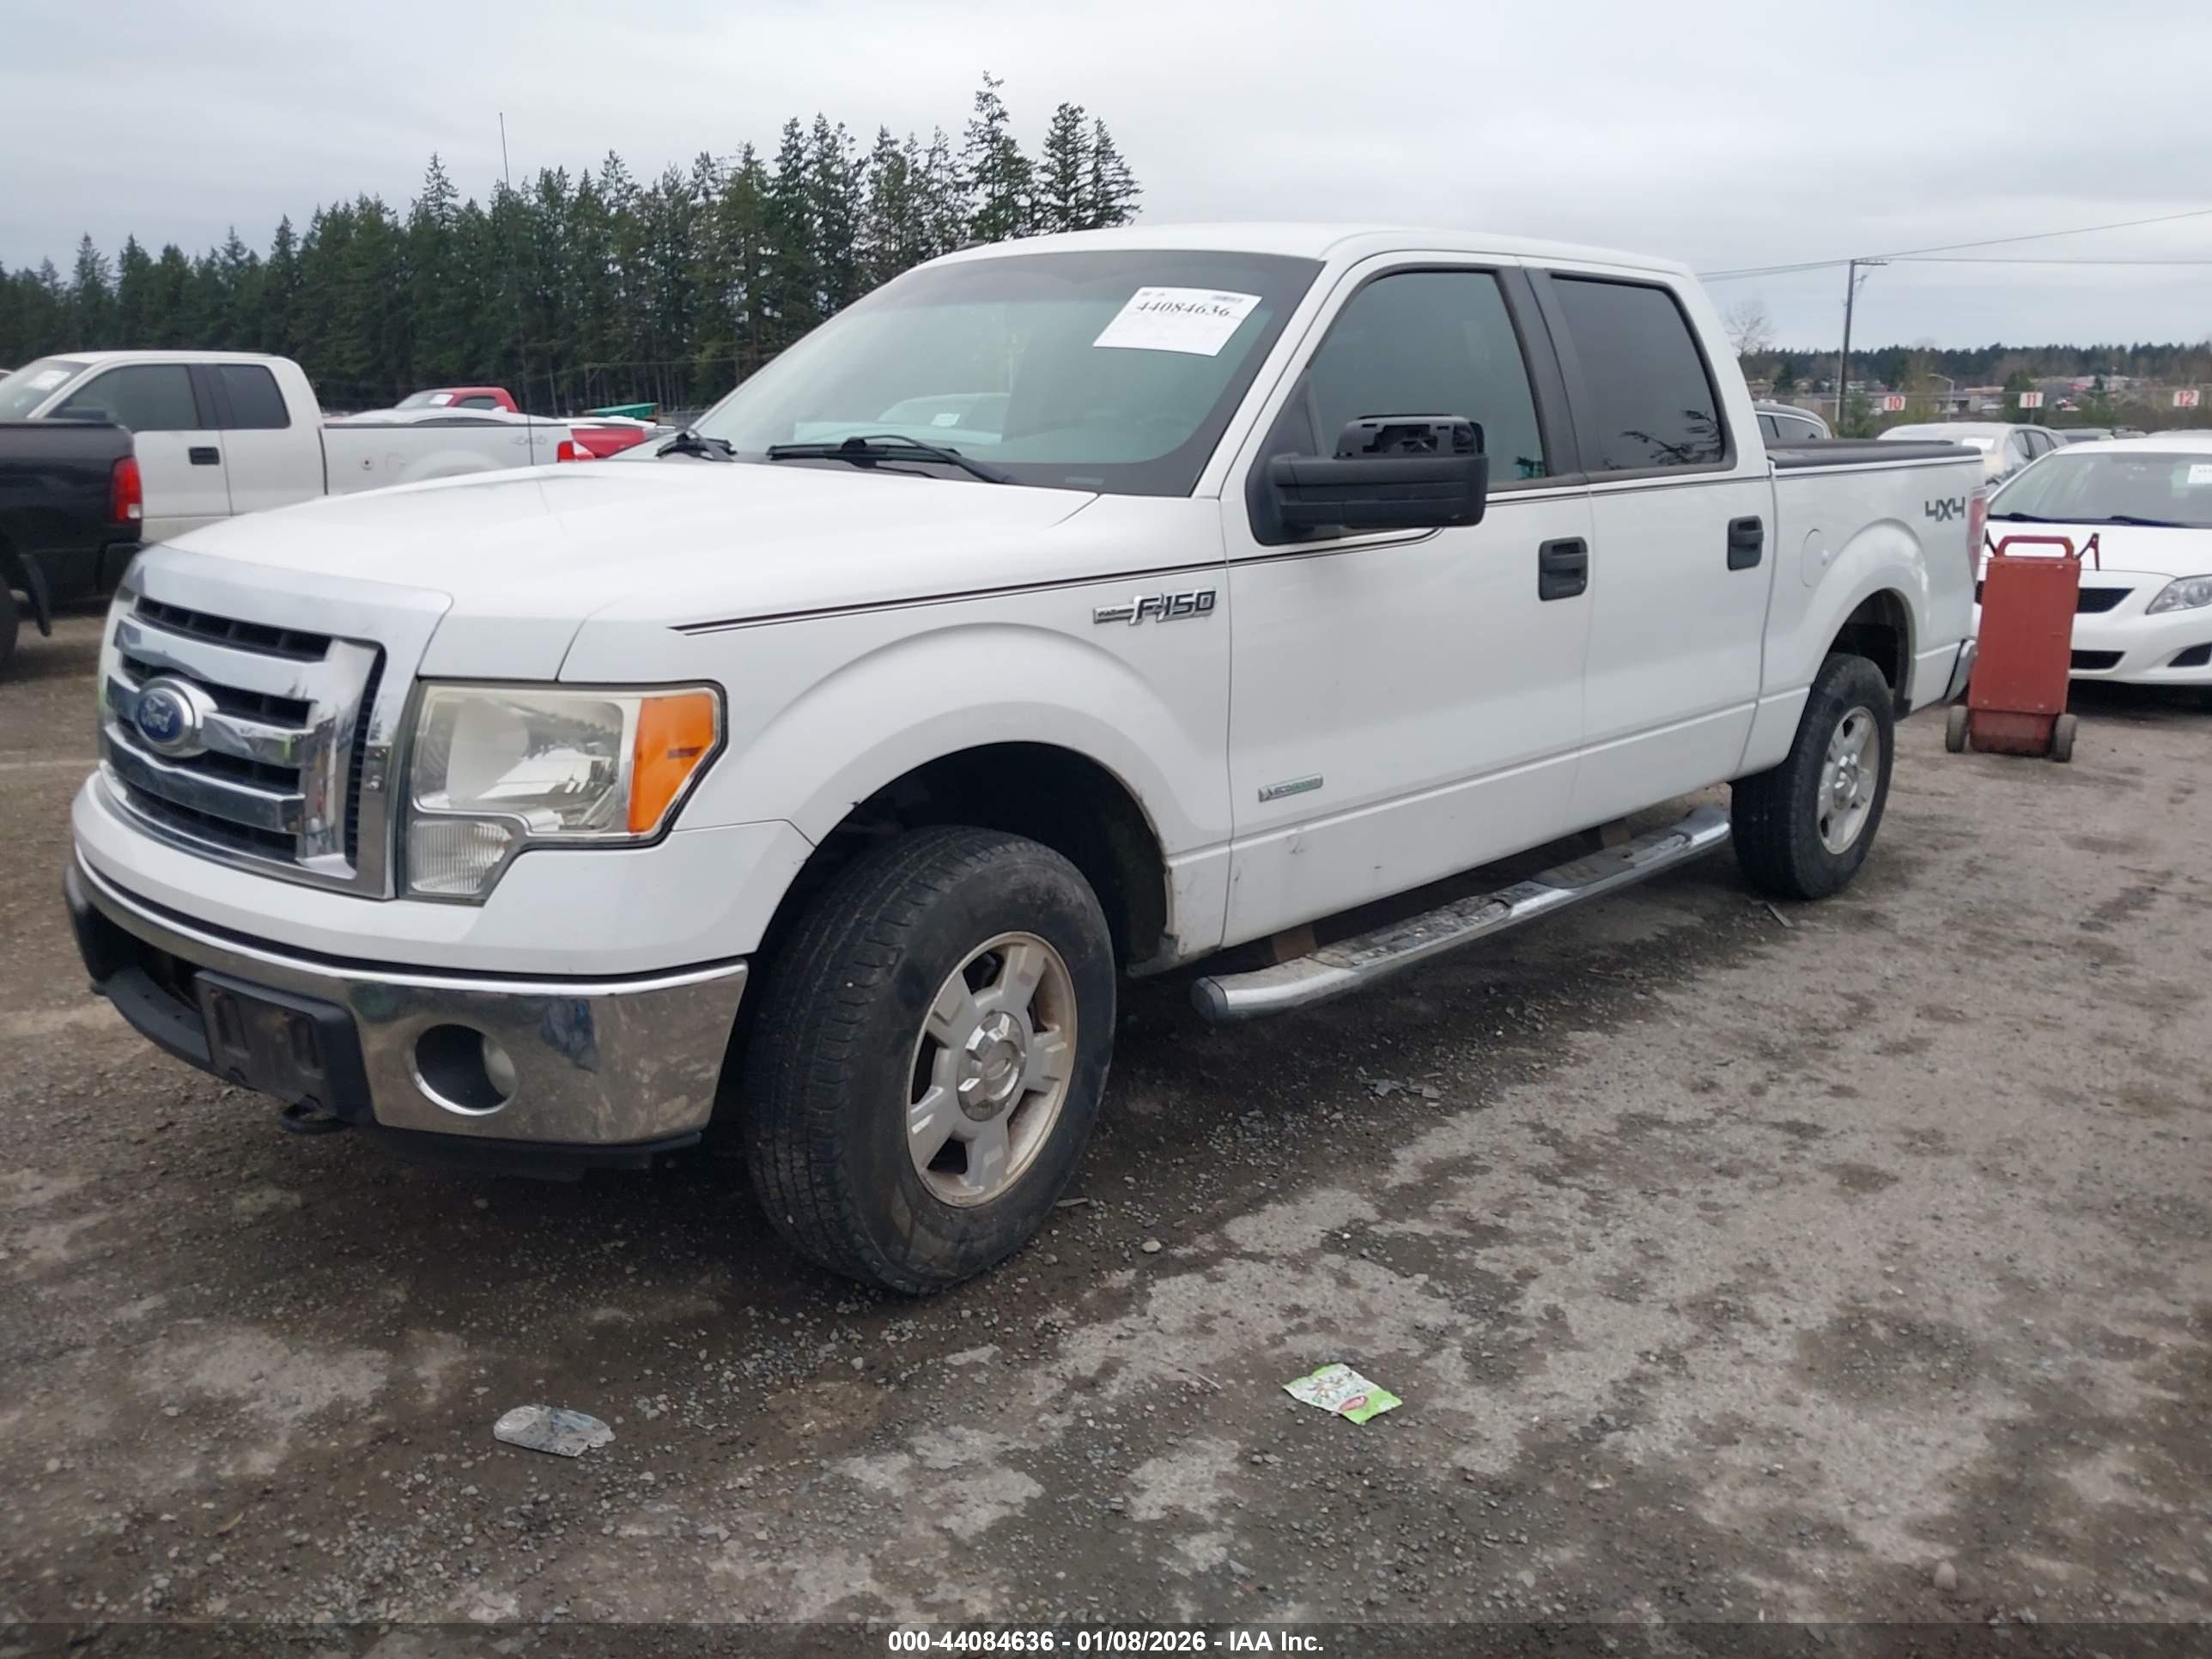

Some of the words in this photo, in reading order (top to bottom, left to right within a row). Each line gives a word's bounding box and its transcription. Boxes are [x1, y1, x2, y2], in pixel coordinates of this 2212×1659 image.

[1137, 301, 1231, 317] 44084636
[1889, 397, 1901, 410] 10
[2179, 392, 2195, 408] 12
